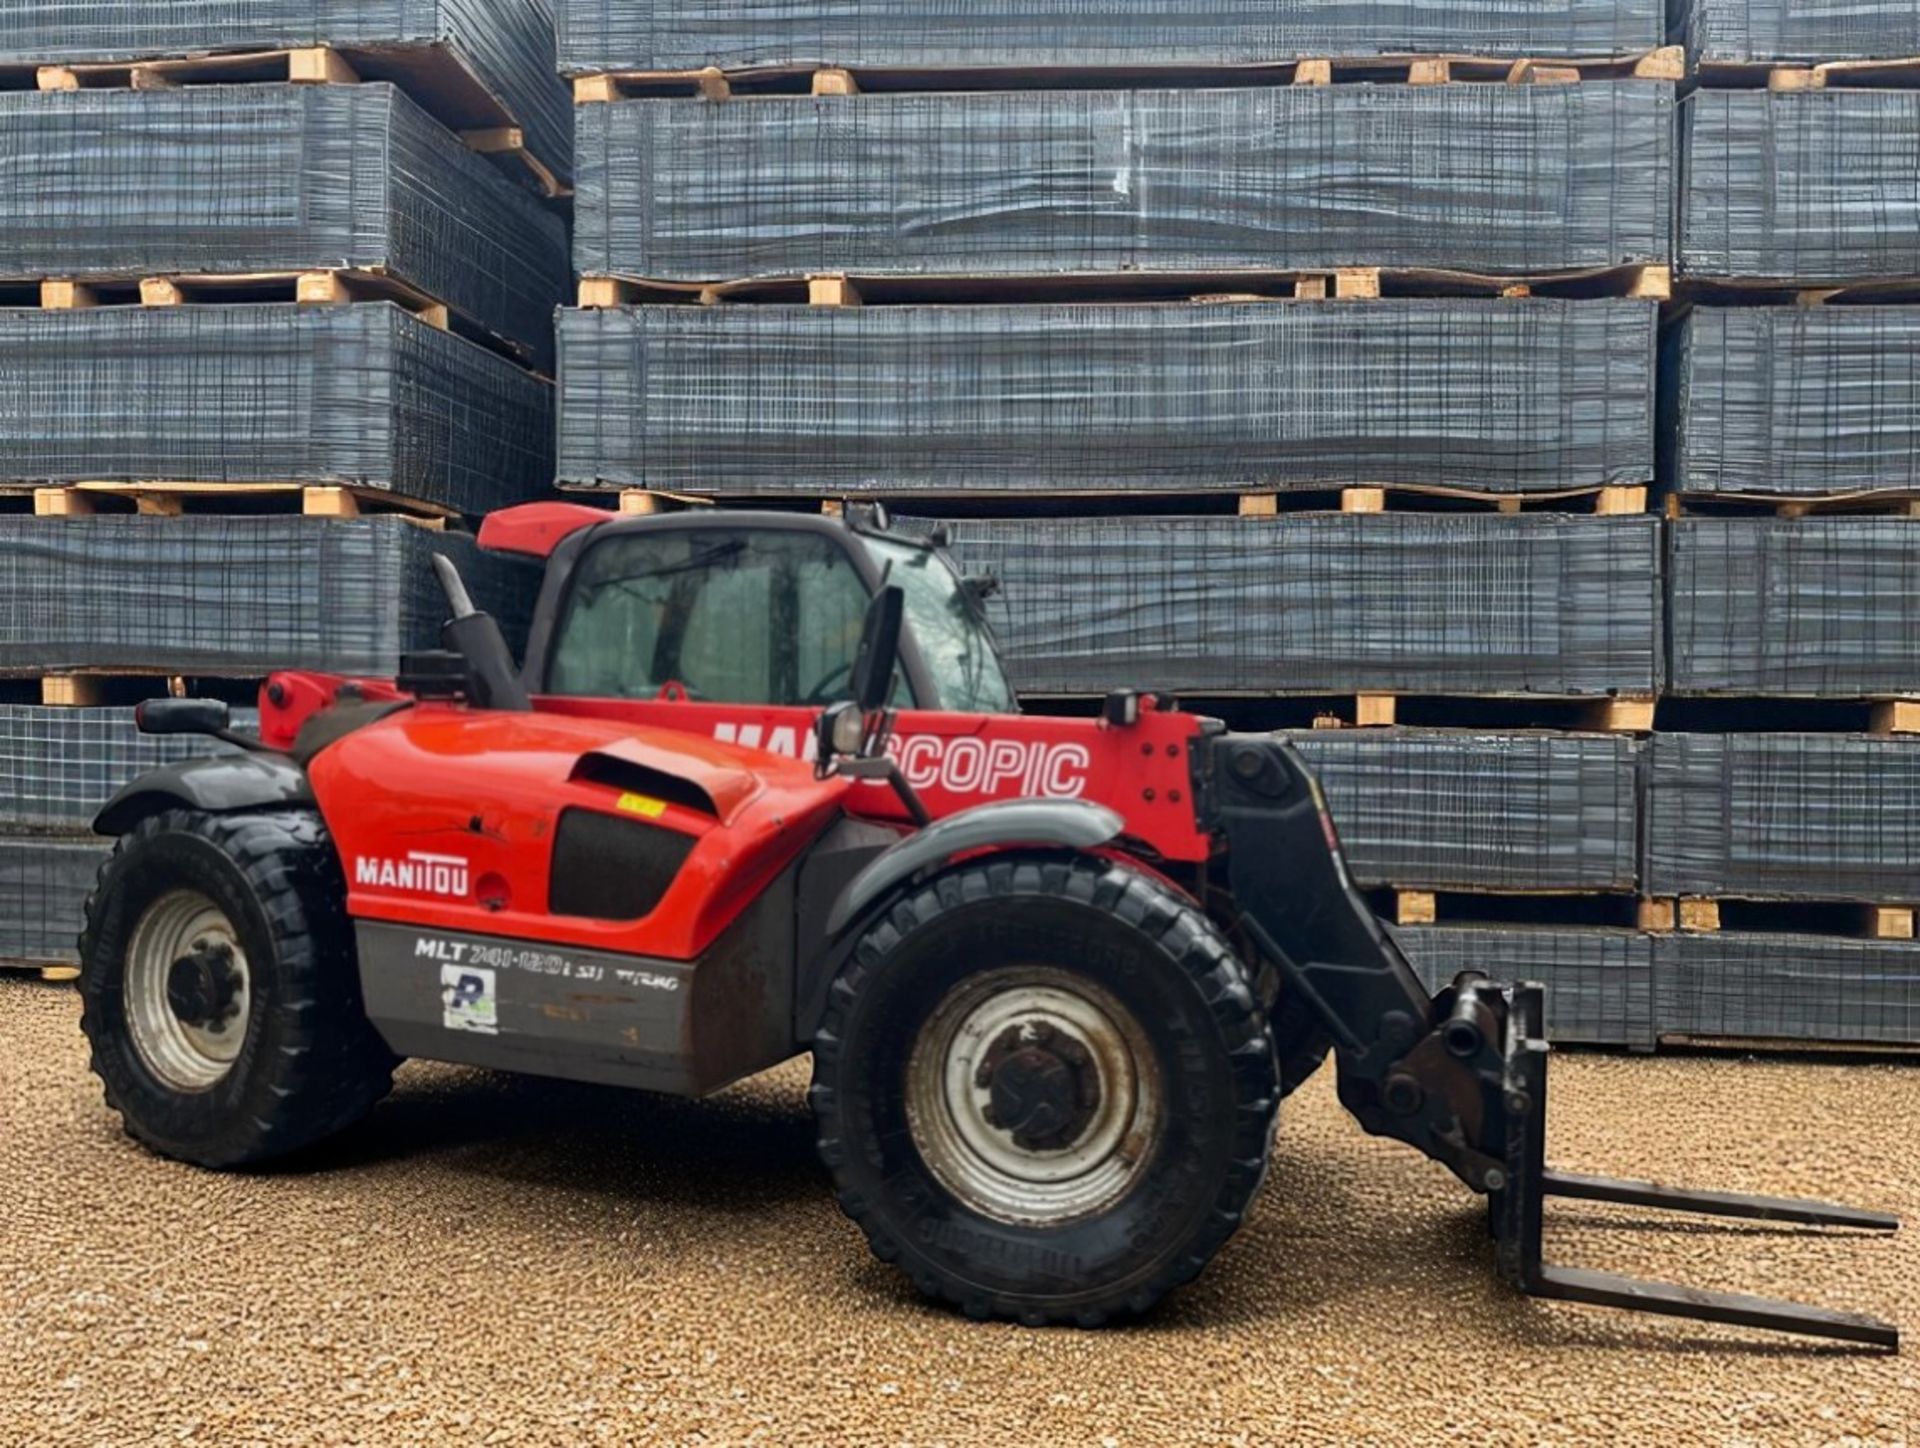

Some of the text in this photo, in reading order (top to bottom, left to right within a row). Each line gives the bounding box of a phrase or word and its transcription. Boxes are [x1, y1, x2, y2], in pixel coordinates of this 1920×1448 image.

[713, 722, 1090, 799] ASCOPIC
[355, 851, 469, 896] MANITOU
[414, 938, 468, 961] MLT
